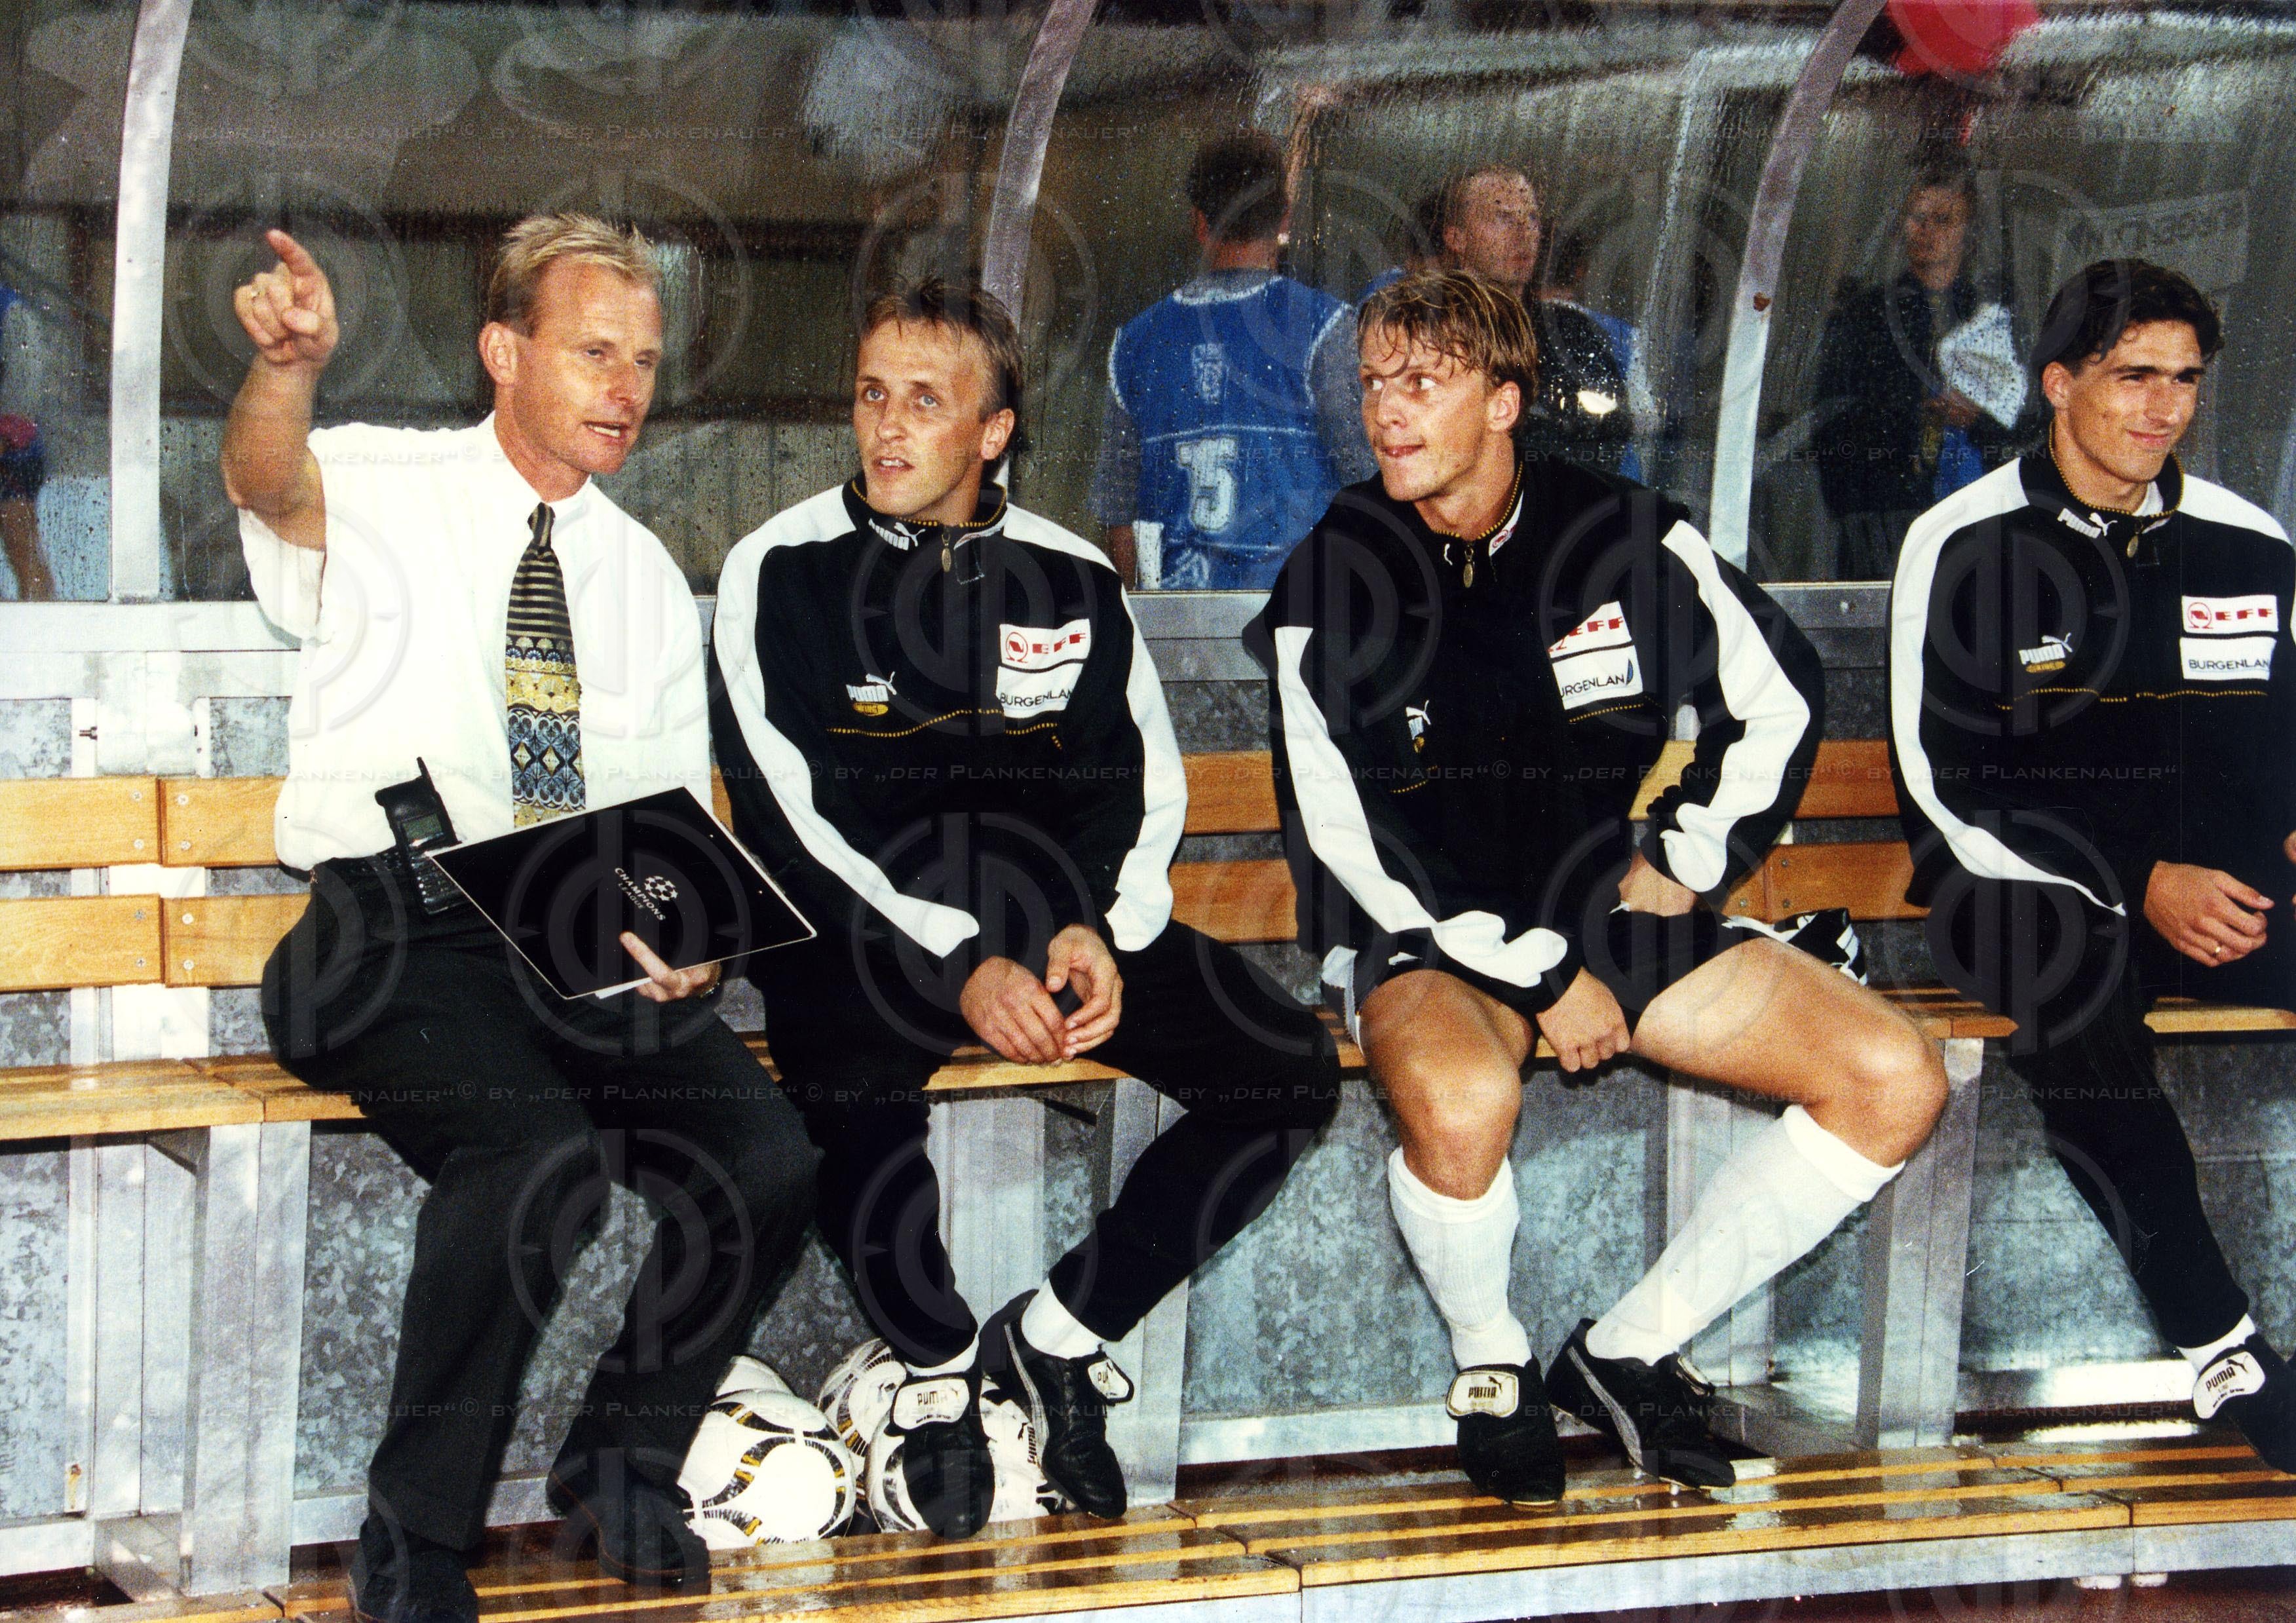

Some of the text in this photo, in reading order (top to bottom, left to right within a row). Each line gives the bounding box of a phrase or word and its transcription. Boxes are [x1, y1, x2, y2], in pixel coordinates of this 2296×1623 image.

[1176, 437, 1238, 532] 5
[615, 868, 666, 921] CHAMPIONS
[1468, 1386, 1497, 1398] PUMA
[2206, 1366, 2236, 1392] PUMA
